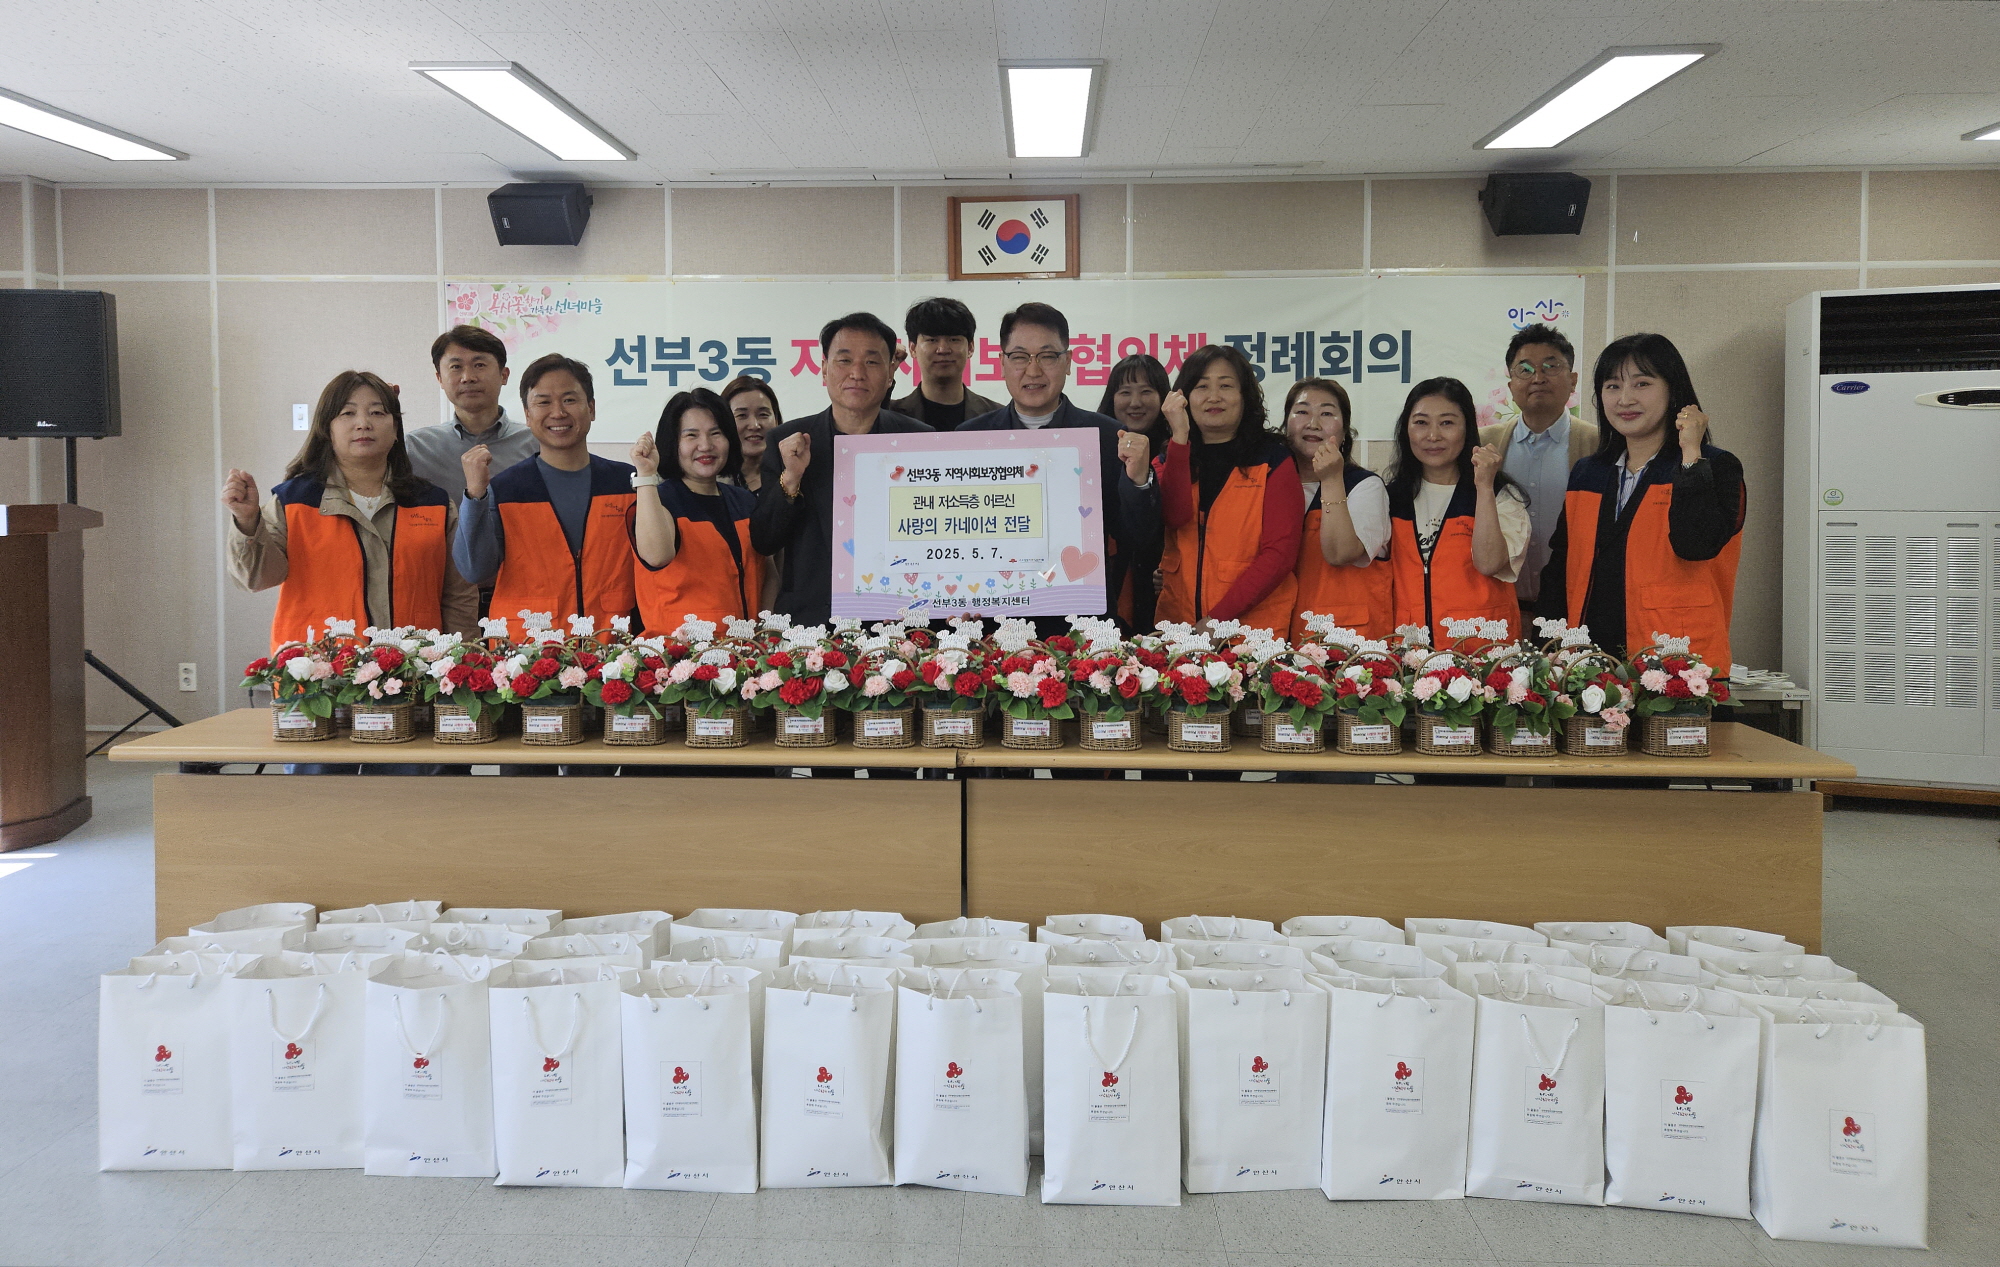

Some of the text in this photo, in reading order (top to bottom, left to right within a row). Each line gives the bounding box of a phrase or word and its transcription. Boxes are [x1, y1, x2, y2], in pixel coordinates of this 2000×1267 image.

[488, 293, 524, 315] 복사꽃
[555, 298, 603, 315] 선녀마을
[605, 335, 777, 387] 선부3동
[1224, 330, 1411, 384] 정례회의
[907, 465, 1025, 482] 선부3동 지역사회보장협의체
[913, 493, 1015, 510] 관내 저소득층 어르신
[898, 515, 1031, 535] 사랑의 카네이션 전달
[926, 547, 1003, 560] 2025. 5. 7.
[932, 596, 1030, 608] 선부3동 행정복지센터
